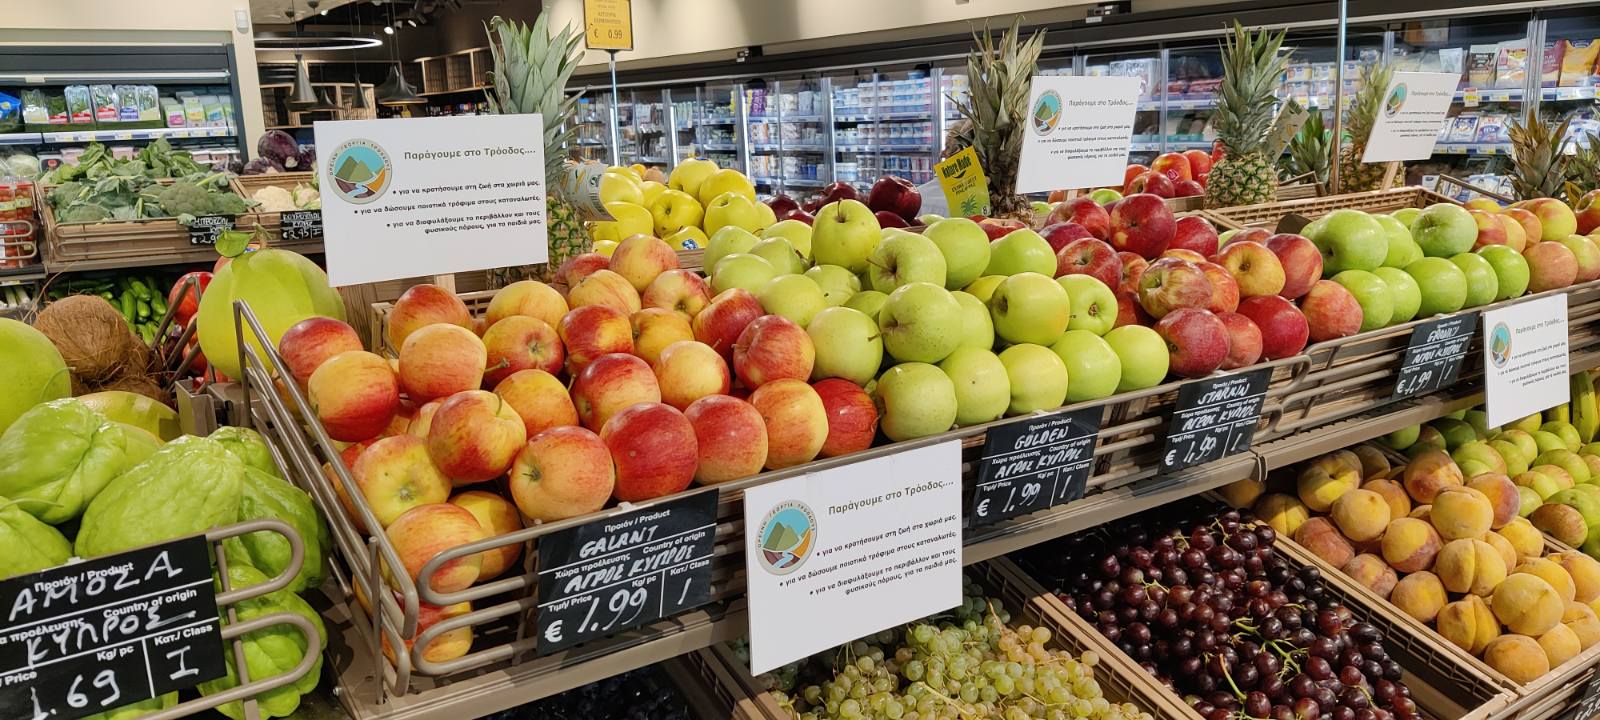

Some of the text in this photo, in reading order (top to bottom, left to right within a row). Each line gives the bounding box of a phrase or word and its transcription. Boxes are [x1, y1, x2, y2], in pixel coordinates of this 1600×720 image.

[608, 29, 622, 39] 0.99
[404, 149, 460, 160] Παράγουμε
[478, 182, 491, 190] ζωή
[384, 203, 415, 212] δώσουμε
[1051, 418, 1072, 427] Product
[1014, 426, 1068, 450] GOLDEN
[1165, 450, 1176, 466] €
[1060, 475, 1072, 498] 1
[828, 496, 883, 515] Παράγουμε
[885, 490, 902, 501] στο
[977, 498, 990, 517] €
[640, 509, 671, 524] Product
[579, 525, 658, 558] GALANT
[643, 531, 706, 554] Country of origin
[822, 548, 833, 557] για
[844, 533, 884, 550] κρατήσουμε
[885, 530, 897, 539] στη
[898, 525, 911, 536] ζωή
[924, 518, 943, 528] χωριά
[87, 562, 134, 580] Product
[554, 553, 631, 580] Χώρα προέλευσης
[628, 545, 696, 577] ΚΥΠΡΟΣ
[690, 559, 710, 571] Class
[785, 578, 796, 588] για
[808, 564, 838, 579] δώσουμε
[840, 556, 867, 568] ποιοτικά
[868, 548, 895, 561] τρόφιμα
[897, 542, 916, 552] στους
[815, 586, 826, 596] για
[837, 568, 884, 588] διαφυλάξουμε
[894, 555, 930, 572] περιβάλλον
[942, 548, 956, 558] τους
[632, 575, 656, 587] Kg/ pc
[845, 582, 877, 596] φυσικούς
[904, 569, 914, 578] για
[924, 561, 943, 572] παιδιά
[571, 594, 592, 606] Price
[677, 577, 692, 605] 1
[103, 589, 198, 618] Country of origin
[545, 588, 648, 642] € 1.99
[10, 618, 85, 642] προέλευσης
[183, 624, 213, 638] Class
[96, 646, 134, 661] Kg/ pc
[5, 672, 38, 687] Price
[30, 669, 120, 720] 1.69
